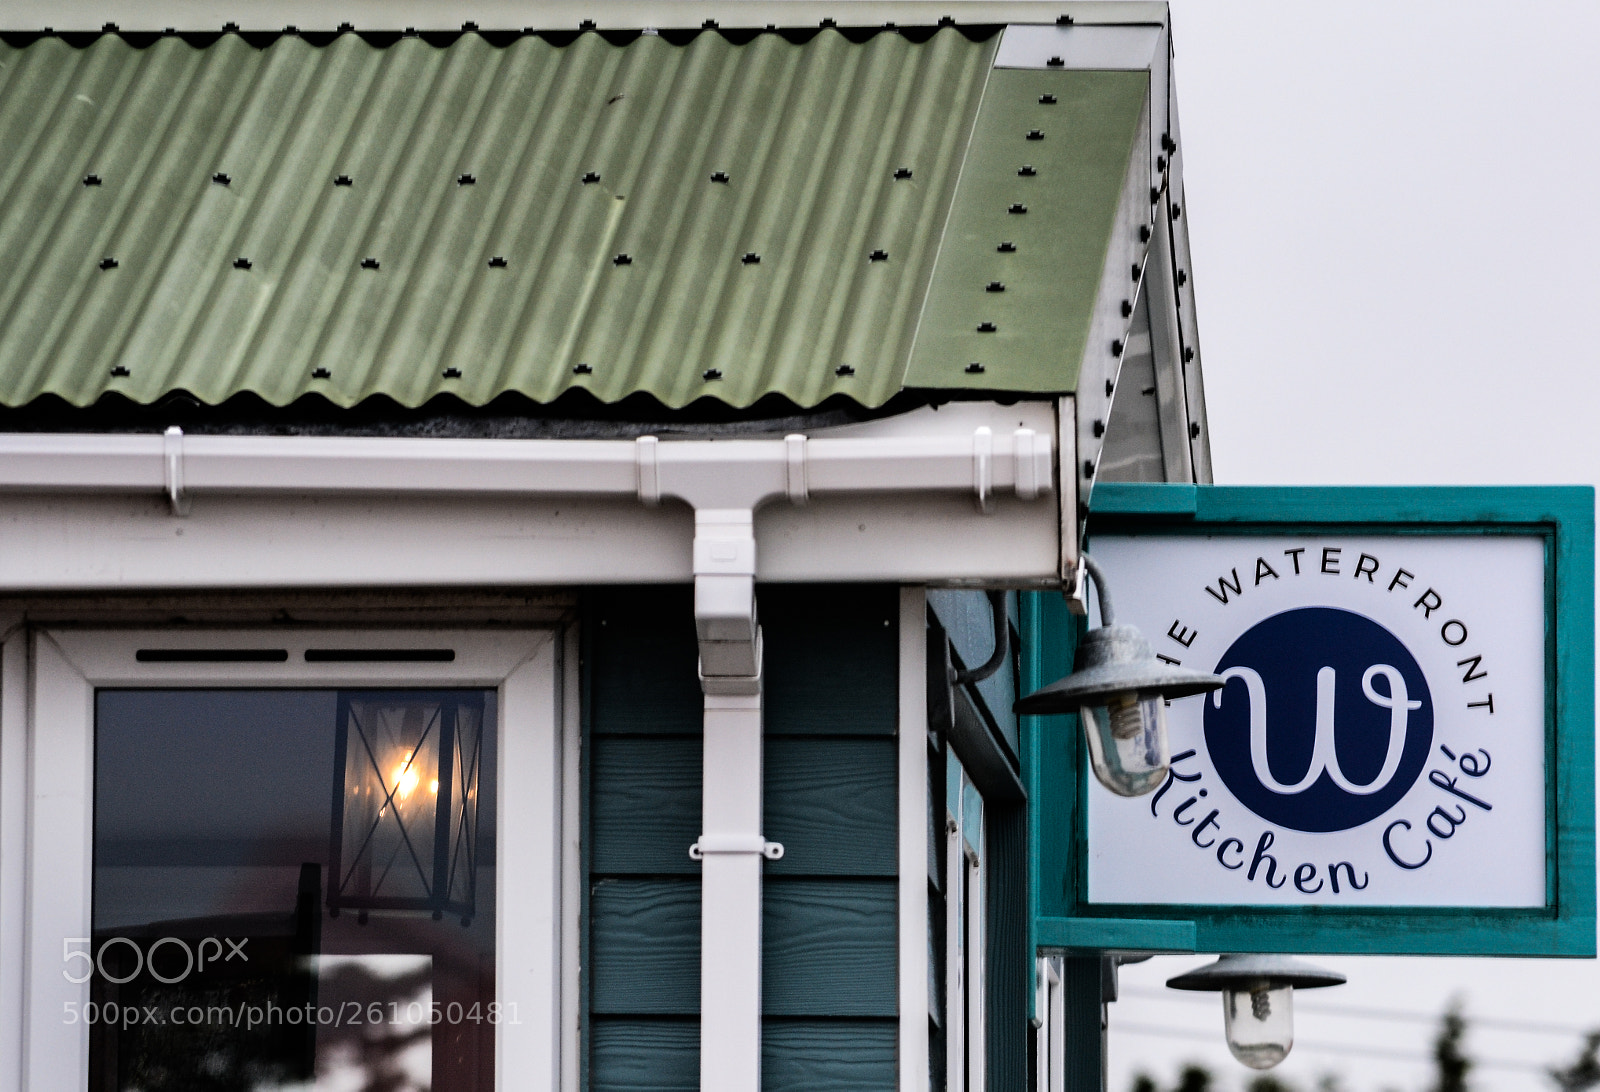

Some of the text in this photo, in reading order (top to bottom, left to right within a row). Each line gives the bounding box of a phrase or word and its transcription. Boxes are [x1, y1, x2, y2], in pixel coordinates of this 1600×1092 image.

[1205, 547, 1494, 714] WATERFRONT
[1151, 744, 1492, 894] Kitchen Café
